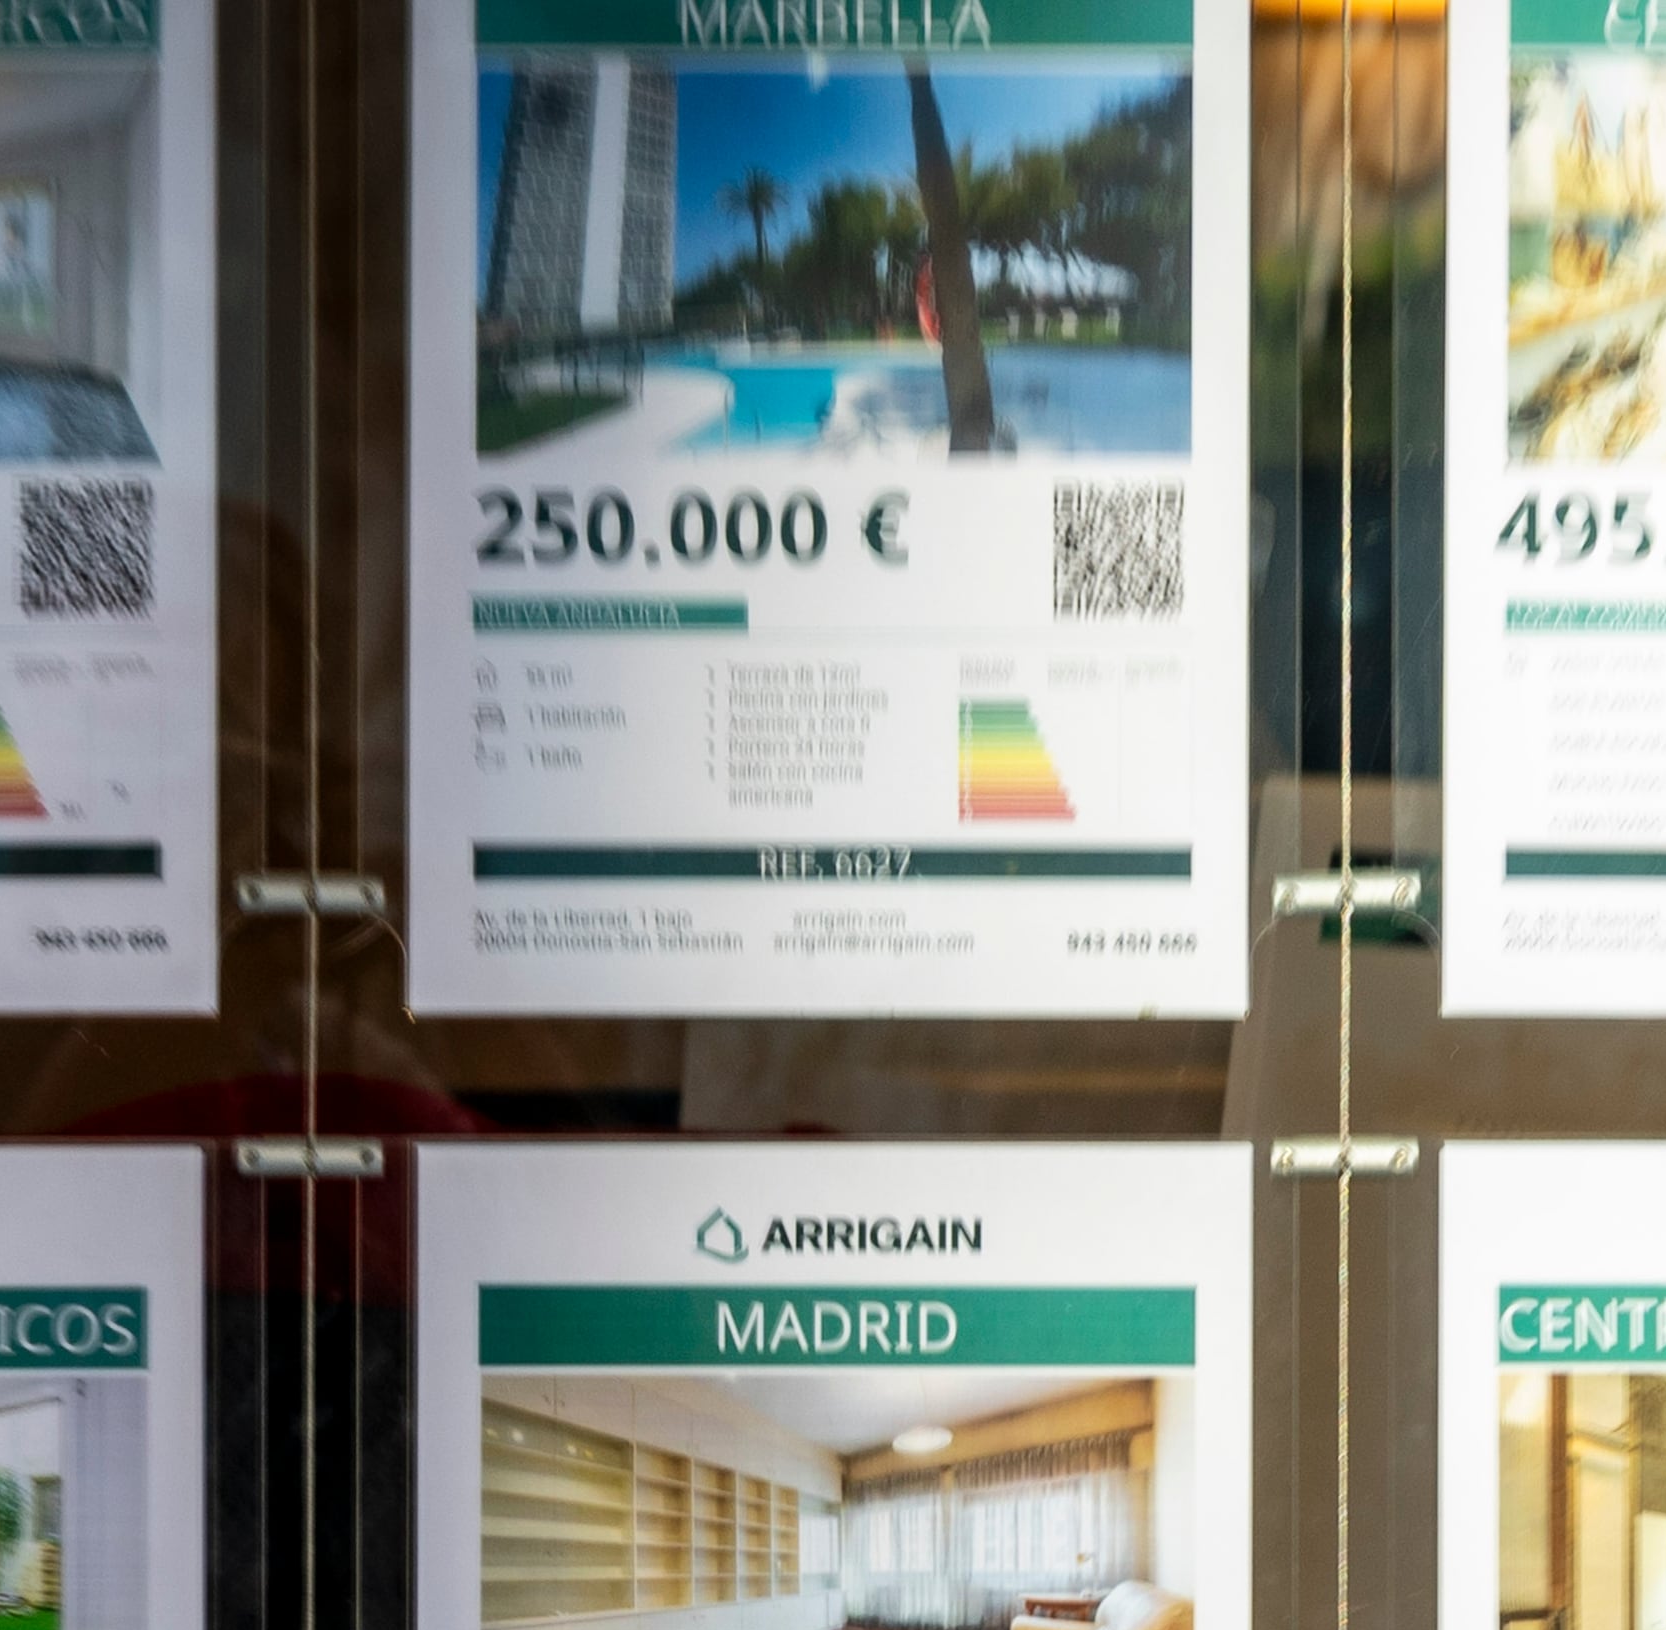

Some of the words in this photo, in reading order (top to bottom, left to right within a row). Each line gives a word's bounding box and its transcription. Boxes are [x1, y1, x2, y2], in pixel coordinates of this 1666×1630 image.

[475, 487, 830, 567] 250.000
[860, 487, 910, 567] €
[762, 1217, 983, 1254] ARRIGAIN
[715, 1299, 958, 1355] MADRID
